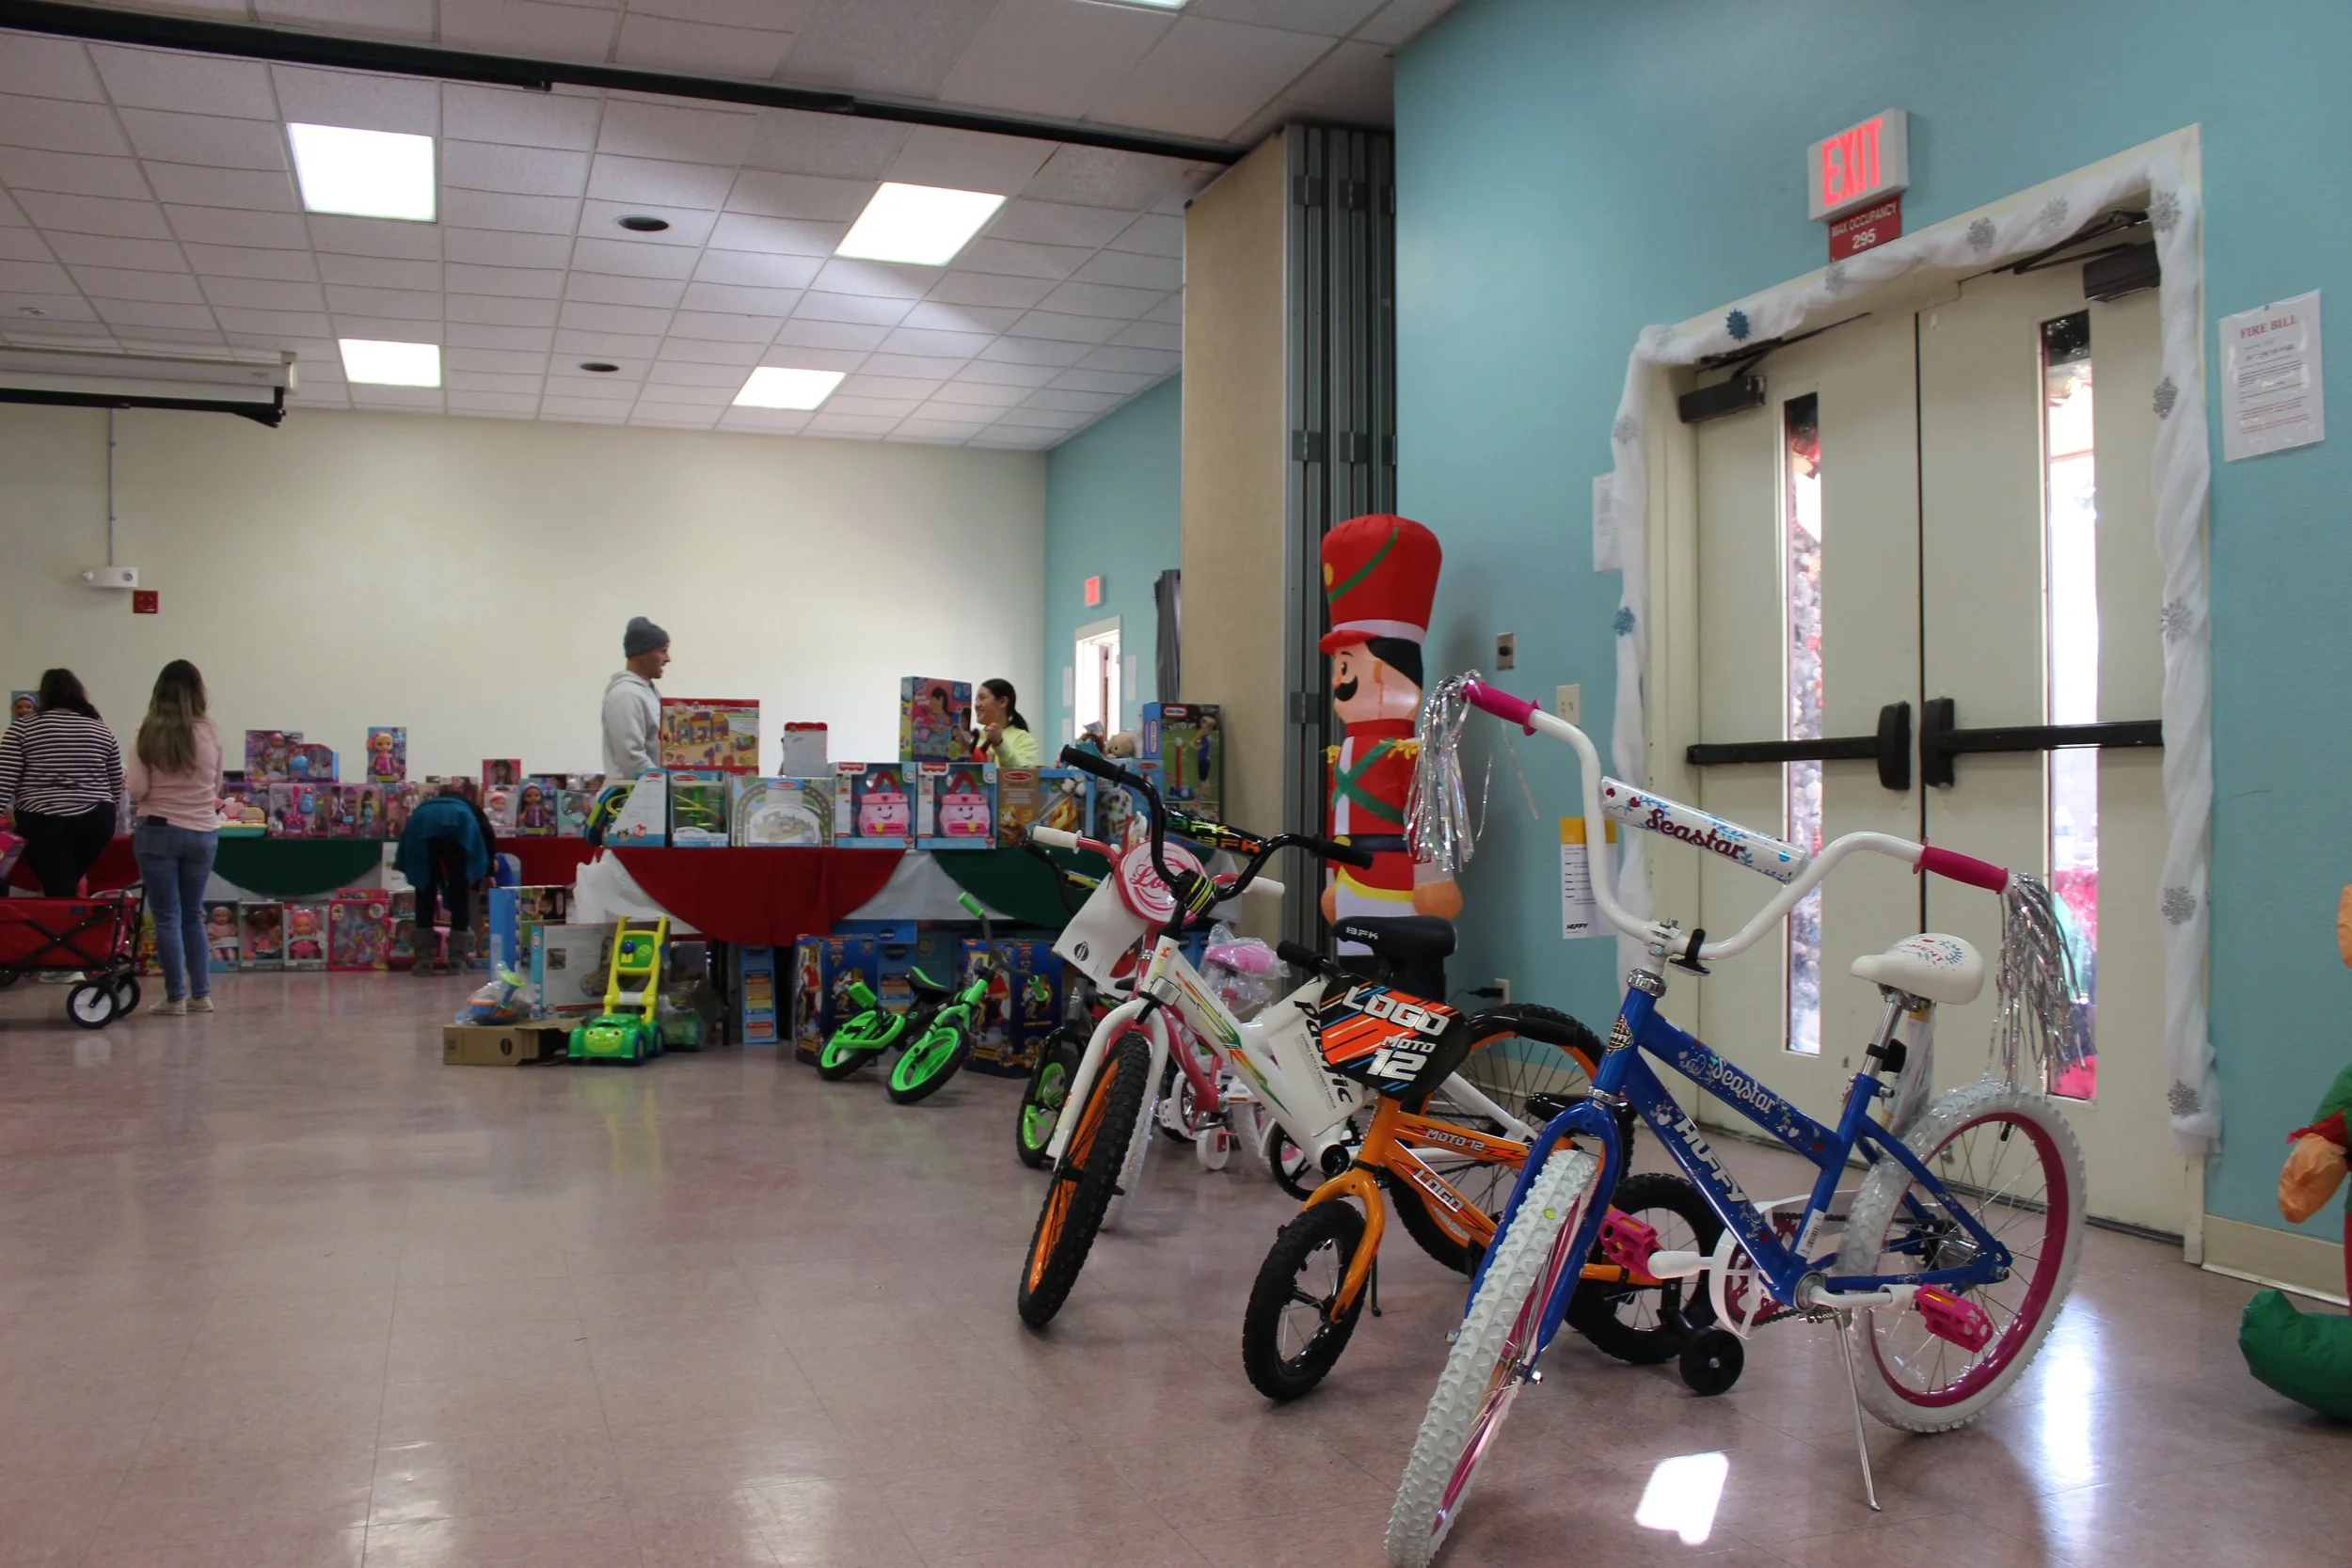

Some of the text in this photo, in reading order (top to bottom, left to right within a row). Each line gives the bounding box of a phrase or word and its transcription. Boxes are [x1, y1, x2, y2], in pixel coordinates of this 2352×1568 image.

[1821, 118, 1884, 208] EXIT
[1831, 201, 1899, 238] MAX OCCUPANCY
[1851, 229, 1877, 250] 295
[2240, 314, 2298, 340] FIRE BILL
[1645, 808, 1747, 860] Seastar
[1345, 926, 1380, 941] BFK
[1342, 986, 1451, 1037] LOGO
[1380, 1036, 1437, 1053] MOTO
[1366, 1049, 1427, 1082] 12
[1713, 1056, 1778, 1115] Seastar
[1424, 1129, 1486, 1151] MOTO 12
[1673, 1117, 1748, 1203] HUFFY
[1413, 1169, 1465, 1213] LOGO
